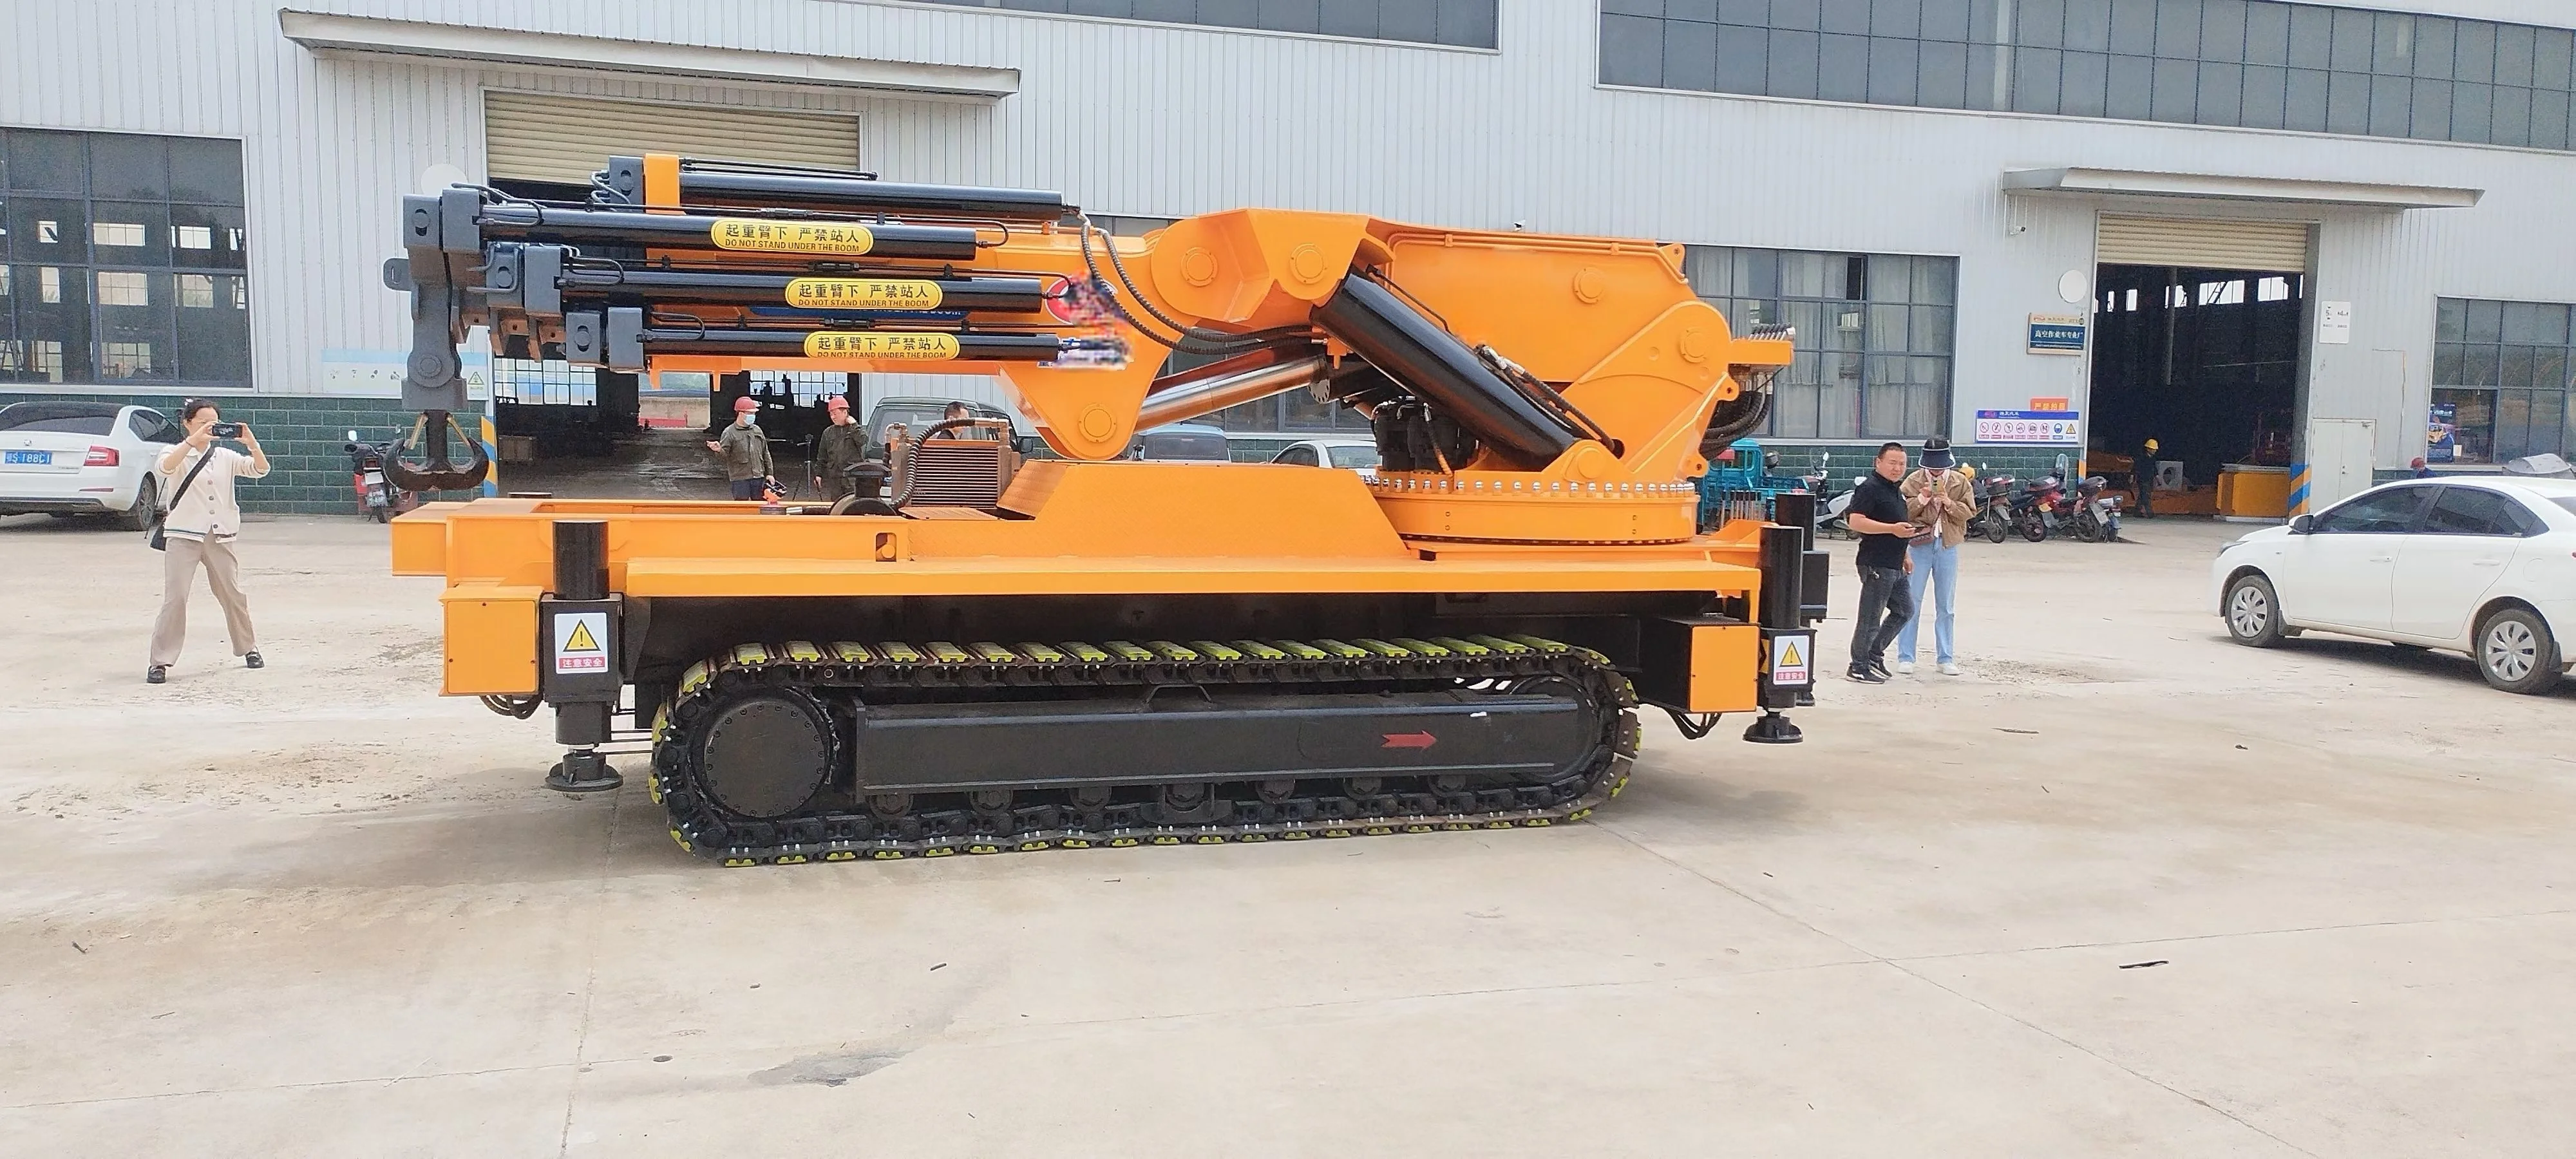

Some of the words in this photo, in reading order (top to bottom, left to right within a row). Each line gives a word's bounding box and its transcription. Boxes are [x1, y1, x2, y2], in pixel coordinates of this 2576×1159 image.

[725, 224, 788, 240] 起重臂下
[798, 227, 859, 243] 严禁站人
[758, 240, 786, 249] STAND
[788, 241, 816, 250] UNDER
[818, 243, 833, 251] THE
[799, 283, 859, 298] 起重臂下
[869, 284, 928, 299] 严禁站人
[818, 337, 877, 351] 起重臂下
[887, 337, 946, 351] 严禁站人
[563, 658, 604, 668] 注意安全
